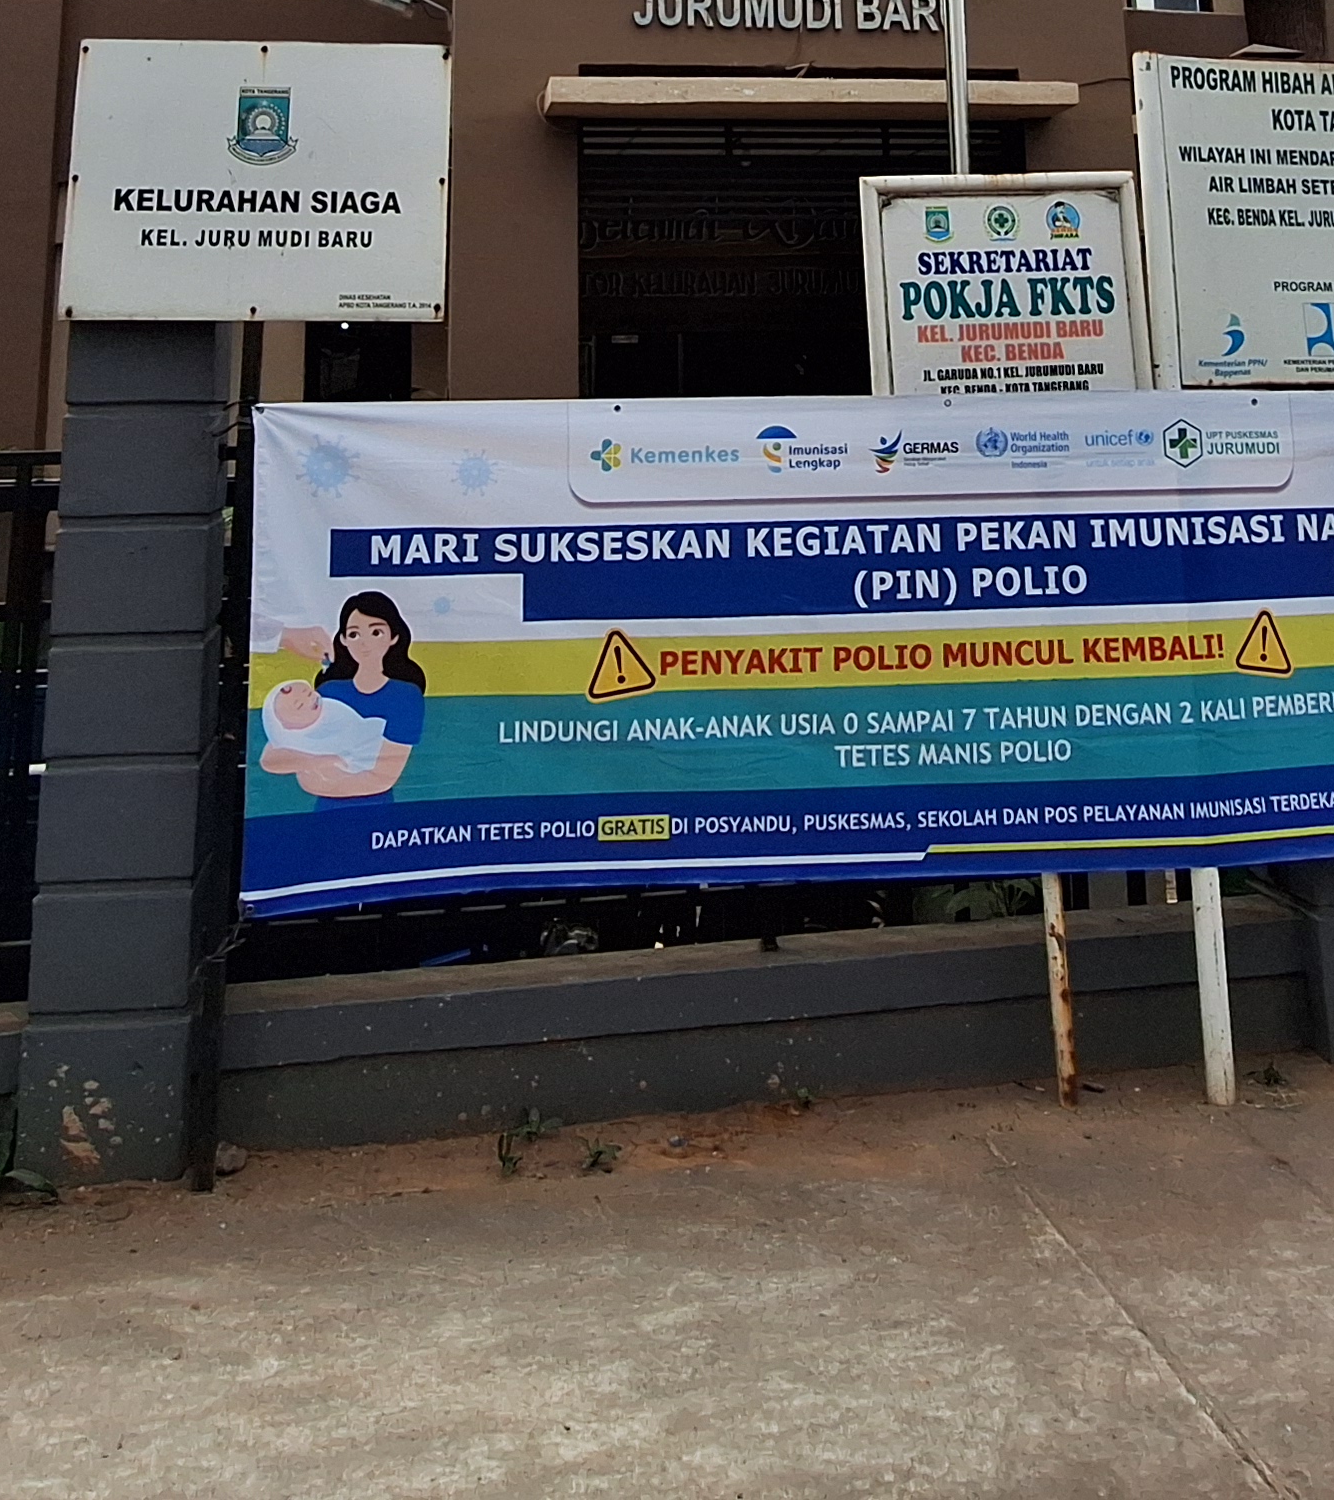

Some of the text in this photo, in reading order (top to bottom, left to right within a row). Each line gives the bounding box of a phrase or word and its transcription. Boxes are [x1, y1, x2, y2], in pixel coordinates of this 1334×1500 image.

[1171, 66, 1256, 92] PROGRAM
[1262, 71, 1315, 94] HIBAH
[1272, 109, 1316, 131] KOTA
[1179, 146, 1245, 164] WILAYAH
[1250, 149, 1271, 164] INI
[1209, 176, 1234, 192] AIR
[1239, 177, 1296, 194] LIMBAH
[114, 189, 400, 214] KELURAHAN SIAGA
[1208, 208, 1234, 225] KEC.
[1237, 209, 1276, 226] BENDA
[1279, 210, 1305, 226] KEL.
[141, 229, 372, 248] KEL. JURU MUDI BARU
[918, 248, 1092, 275] SEKRETARIAT
[1274, 281, 1332, 291] PROGRAM
[900, 278, 1021, 320] POKJA
[1027, 276, 1115, 316] FKTS
[918, 319, 1104, 343] KEL. JURUMUDI BARU
[961, 342, 1064, 363] KEC. BENDA
[924, 370, 935, 381] JL.
[937, 368, 978, 381] GARUDA
[1025, 364, 1075, 377] JURUMUDI
[1078, 364, 1103, 375] BARU
[1198, 360, 1246, 368] Kementerian
[1215, 369, 1252, 377] Bappenas
[1010, 432, 1069, 441] World Health
[1085, 430, 1133, 446] unicef
[1206, 430, 1278, 439] UPT PUSKESMAS
[630, 446, 739, 464] Kemenkes
[788, 443, 848, 456] Imunisasi
[903, 442, 959, 454] GERMAS
[1010, 442, 1069, 455] Organization
[1206, 442, 1280, 455] JURUMUDI
[788, 457, 841, 470] Lengkap
[371, 534, 478, 564] MARI
[495, 529, 729, 562] SUKSESKAN
[747, 524, 940, 557] KEGIATAN
[957, 520, 1076, 551] PEKAN
[1090, 515, 1285, 547] IMUNISASI
[855, 565, 1087, 608] (PIN) POLIO
[660, 634, 1224, 675] PENYAKIT POLIO MUNCUL KEMBALI!
[500, 720, 617, 742] LINDUNGI
[627, 715, 772, 741] ANAK-ANAK
[781, 714, 835, 735] USIA
[867, 710, 953, 733] SAMPAI
[963, 709, 976, 730] 7
[983, 706, 1066, 729] TAHUN
[1076, 703, 1171, 726] DENGAN
[1180, 702, 1193, 723] 2
[1201, 698, 1245, 722] KALI
[834, 739, 1071, 767] TETES MANIS POLIO
[372, 825, 471, 849] DAPATKAN
[477, 823, 533, 840] TETES
[541, 821, 594, 838] POLIO
[602, 819, 664, 835] GRATIS
[672, 818, 687, 834] DI
[695, 816, 796, 834] POSYANDU,
[805, 812, 911, 830] PUSKESMAS,
[918, 809, 997, 827] SEKOLAH
[1003, 808, 1038, 824] DAN
[1045, 807, 1077, 823] POS
[1084, 803, 1184, 822] PELAYANAN
[1190, 797, 1266, 818] IMUNISASI
